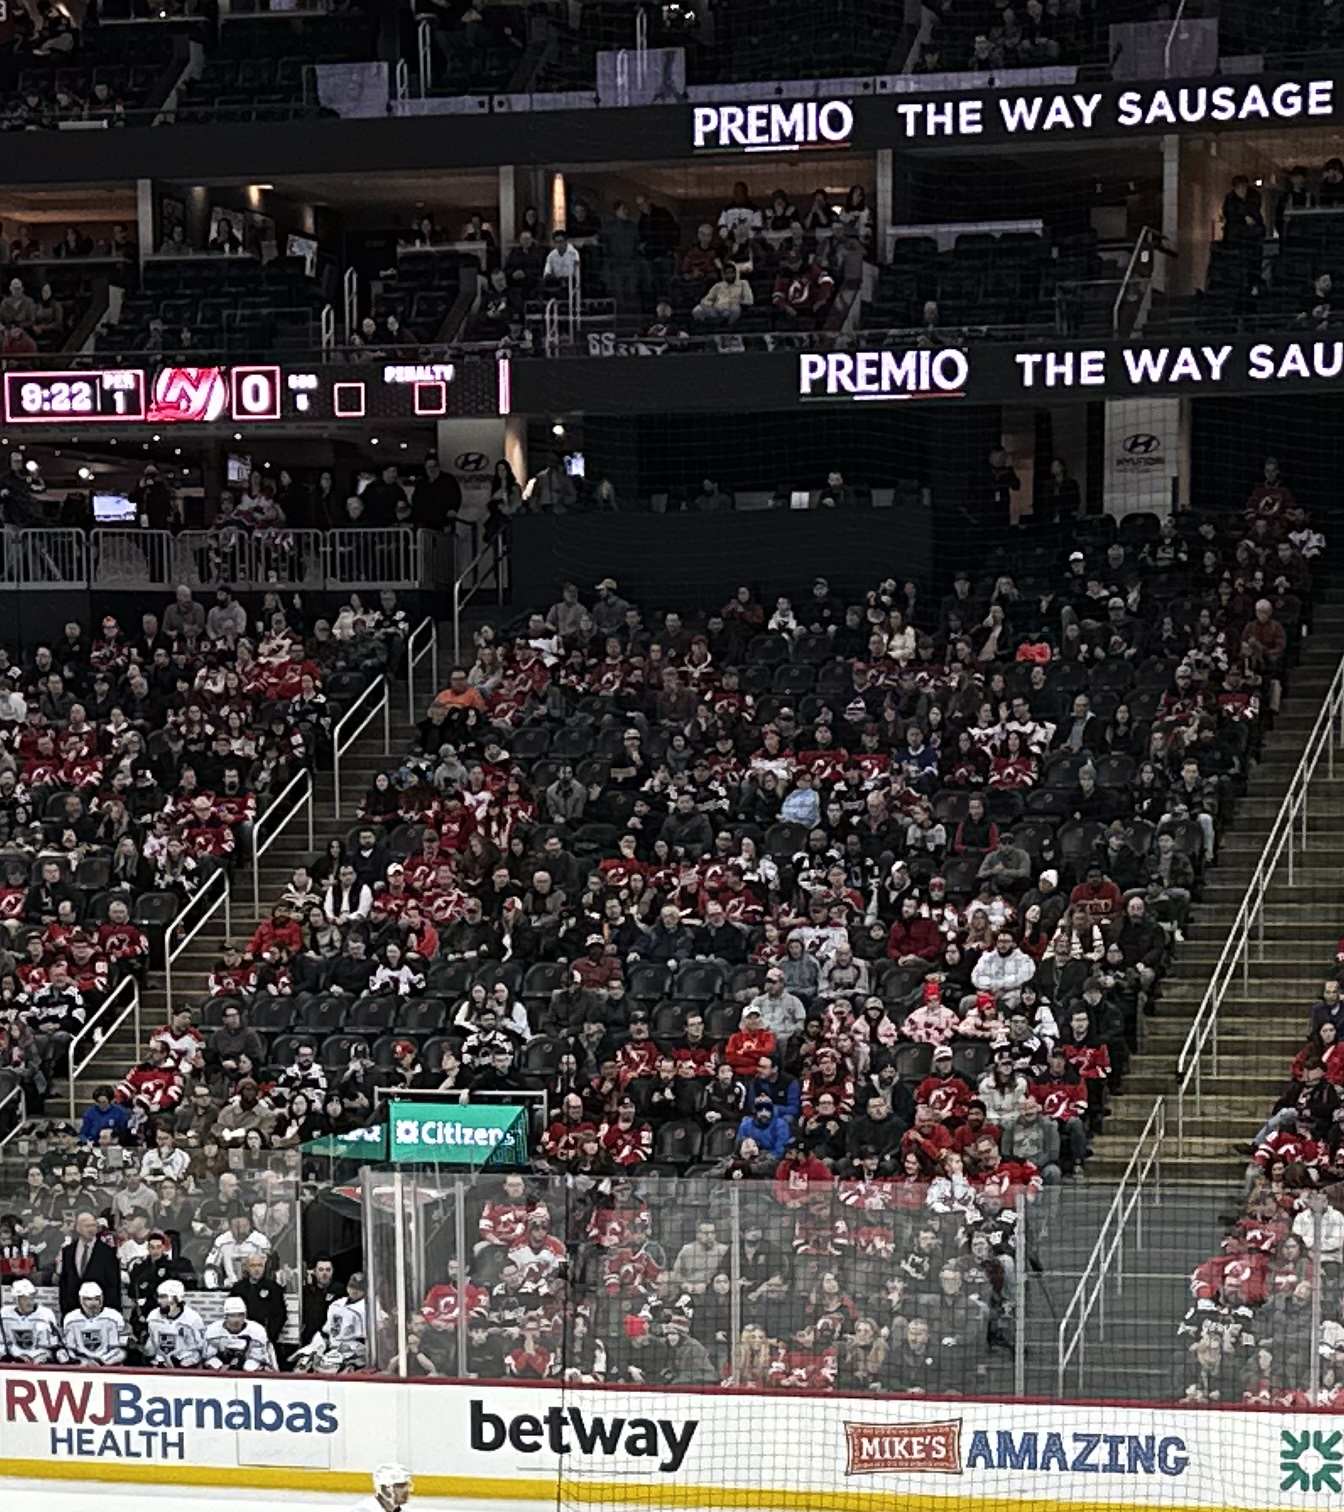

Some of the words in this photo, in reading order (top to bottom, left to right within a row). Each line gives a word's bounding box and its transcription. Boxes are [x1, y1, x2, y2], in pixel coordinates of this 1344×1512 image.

[694, 101, 854, 146] PREMIO
[898, 101, 984, 136] THE
[1000, 94, 1102, 131] WAY
[1118, 80, 1334, 125] SAUSAGE
[800, 349, 969, 393] PREMIO
[1016, 351, 1106, 386] THE
[1123, 346, 1233, 383] WAY
[113, 391, 125, 413] 1
[242, 375, 270, 412] 0
[50, 1428, 185, 1460] HEALTH
[470, 1400, 699, 1473] betway
[860, 1436, 948, 1462] MIKE'S
[966, 1430, 1190, 1477] AMAZING
